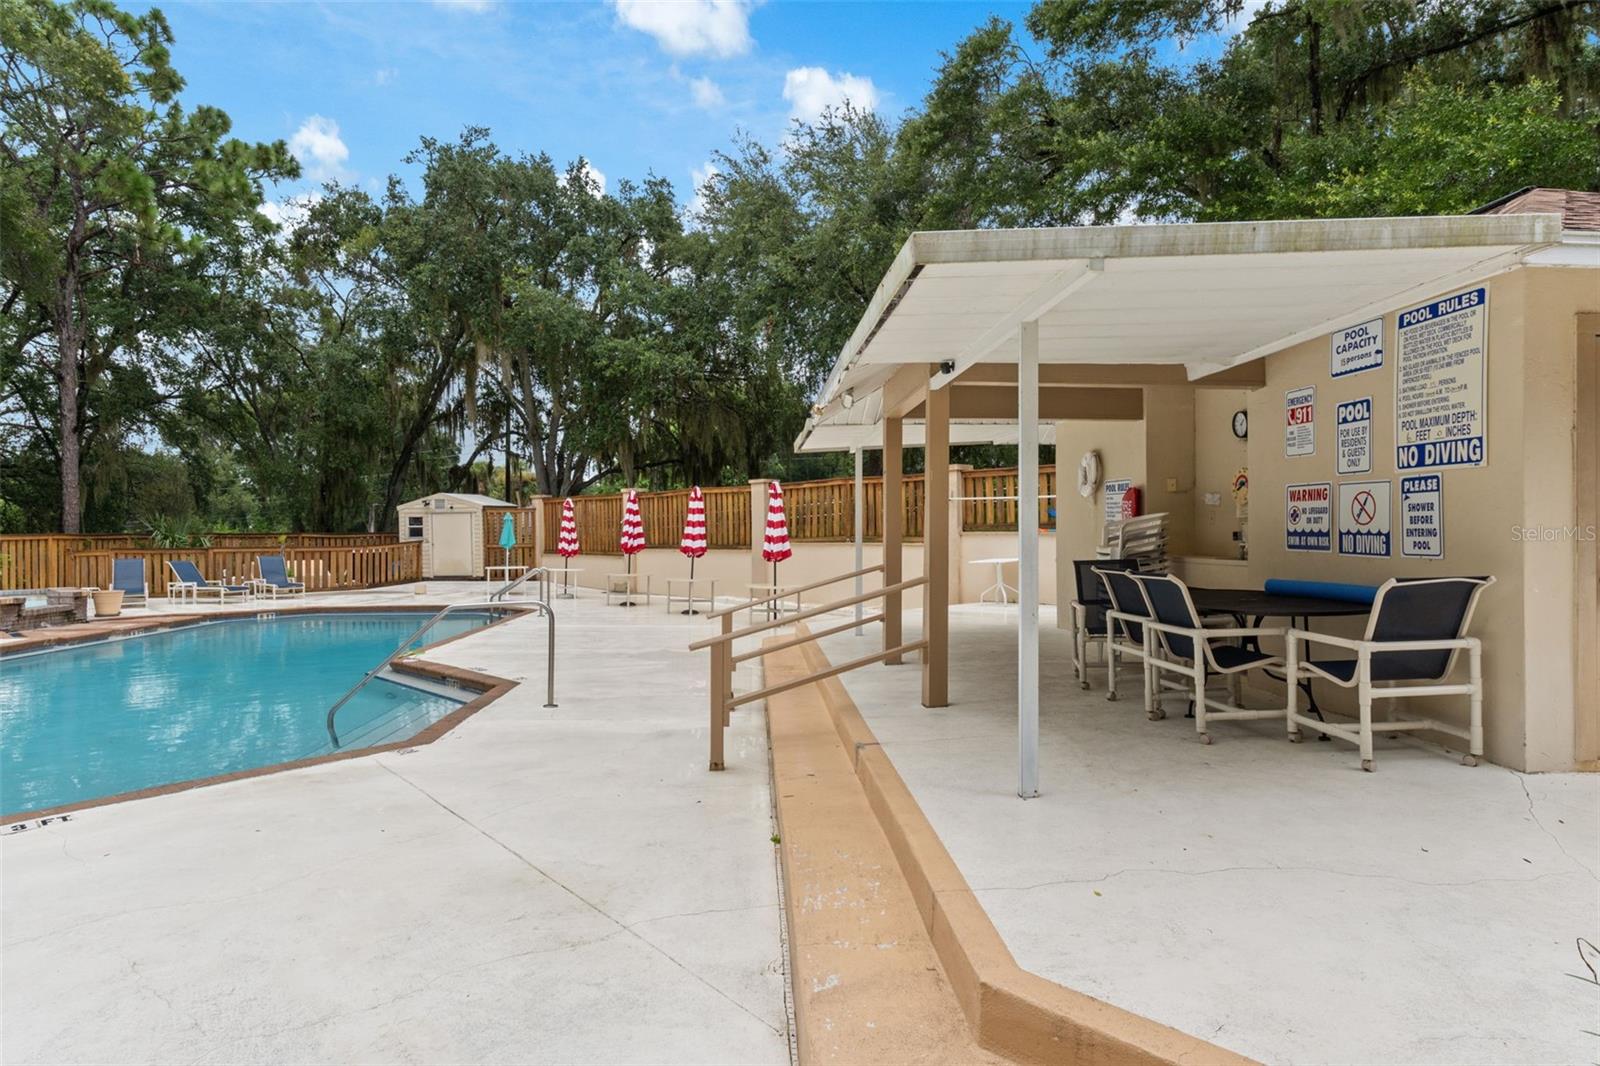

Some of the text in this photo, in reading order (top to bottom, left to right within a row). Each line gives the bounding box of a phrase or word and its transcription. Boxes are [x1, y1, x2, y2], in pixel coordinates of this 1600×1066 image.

[1403, 291, 1478, 326] POOL RULES
[1344, 326, 1369, 342] POOL
[1336, 335, 1378, 355] CAPACITY
[1296, 406, 1312, 424] 911
[1339, 402, 1369, 423] POOL
[1401, 419, 1418, 431] POOL
[1419, 414, 1451, 429] MAXIMUM
[1340, 429, 1350, 438] FOR
[1351, 427, 1361, 437] USE
[1415, 429, 1431, 441] FEET
[1446, 424, 1472, 438] INCHES
[1399, 439, 1481, 467] NO DIVING
[1403, 479, 1438, 492] PLEASE
[1289, 488, 1328, 502] WARNING
[1408, 503, 1434, 512] SHOWER
[1409, 516, 1433, 525] BEFORE
[1406, 528, 1438, 537] ENTERING
[1342, 534, 1387, 555] NO DIVING
[1412, 541, 1431, 550] POOL
[41, 814, 72, 826] FT
